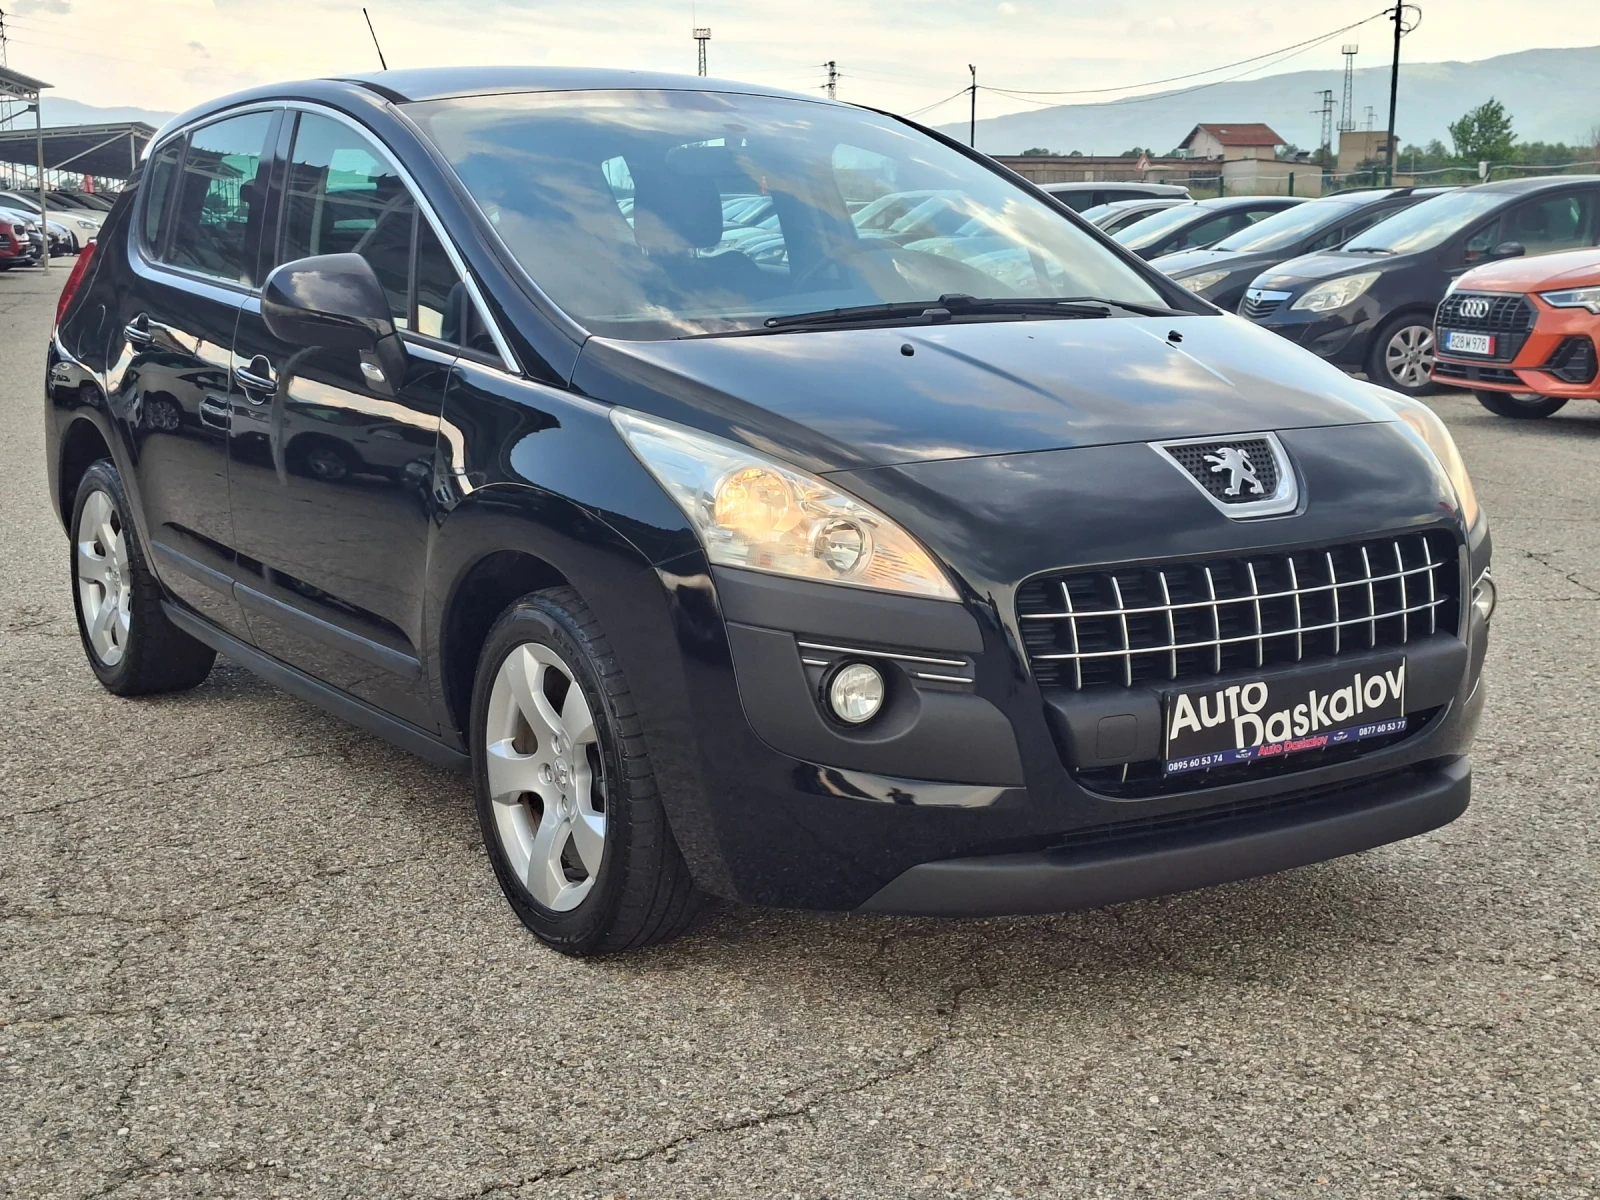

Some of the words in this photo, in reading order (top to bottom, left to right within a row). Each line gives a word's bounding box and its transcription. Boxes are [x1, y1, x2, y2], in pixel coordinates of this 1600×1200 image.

[1234, 665, 1405, 749] Daskalov
[1359, 725, 1376, 736] 0877
[1377, 724, 1386, 733] 60
[1387, 722, 1396, 731] 53
[1397, 720, 1406, 729] 77
[1257, 743, 1282, 757] Auto
[1283, 735, 1329, 752] Daskalov
[1168, 760, 1188, 772] 0895
[1189, 758, 1200, 767] 60
[1201, 756, 1211, 765] 53
[1213, 754, 1223, 763] 74
